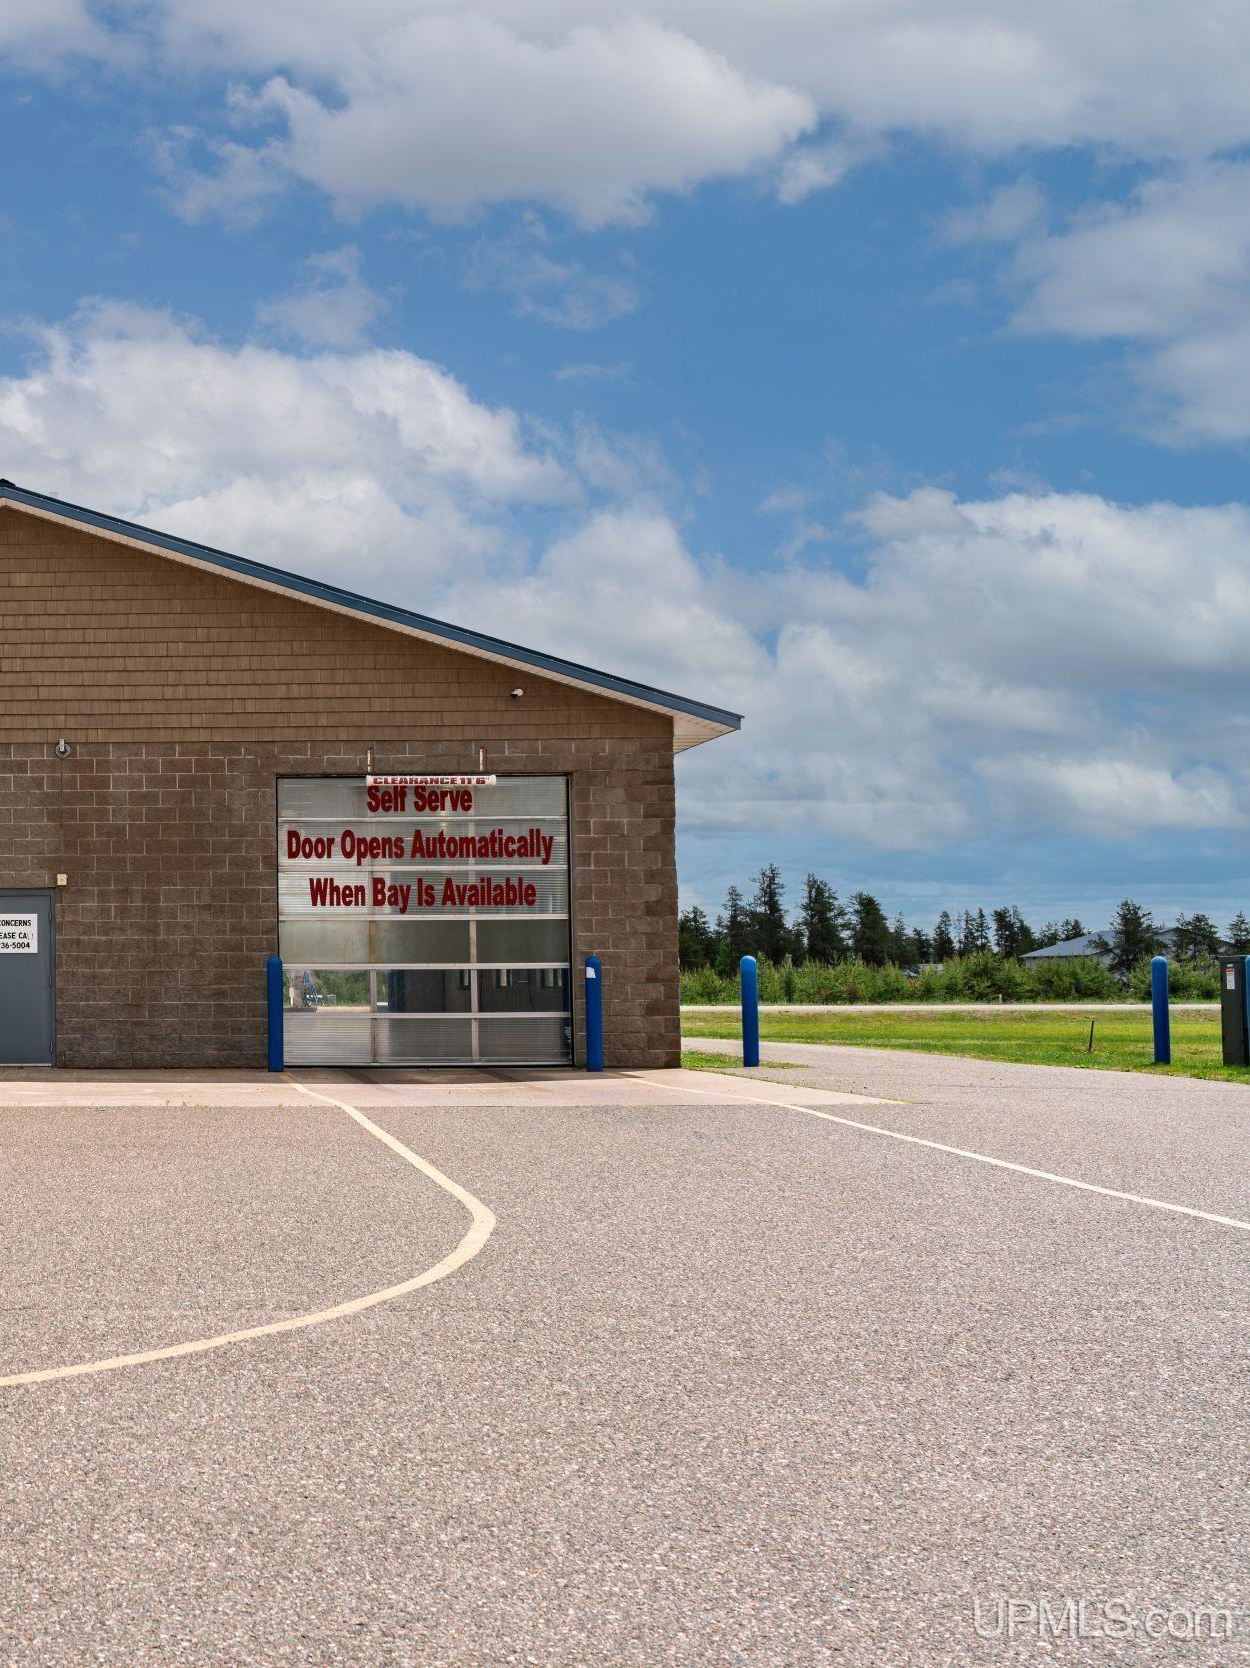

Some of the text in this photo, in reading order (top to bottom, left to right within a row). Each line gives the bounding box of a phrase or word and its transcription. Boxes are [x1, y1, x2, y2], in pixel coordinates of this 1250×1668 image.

[373, 776, 458, 785] CLEARANCE
[366, 784, 473, 813] Self Serve
[287, 828, 554, 866] Door Opens Automatically
[309, 876, 537, 914] When Bay Is Available
